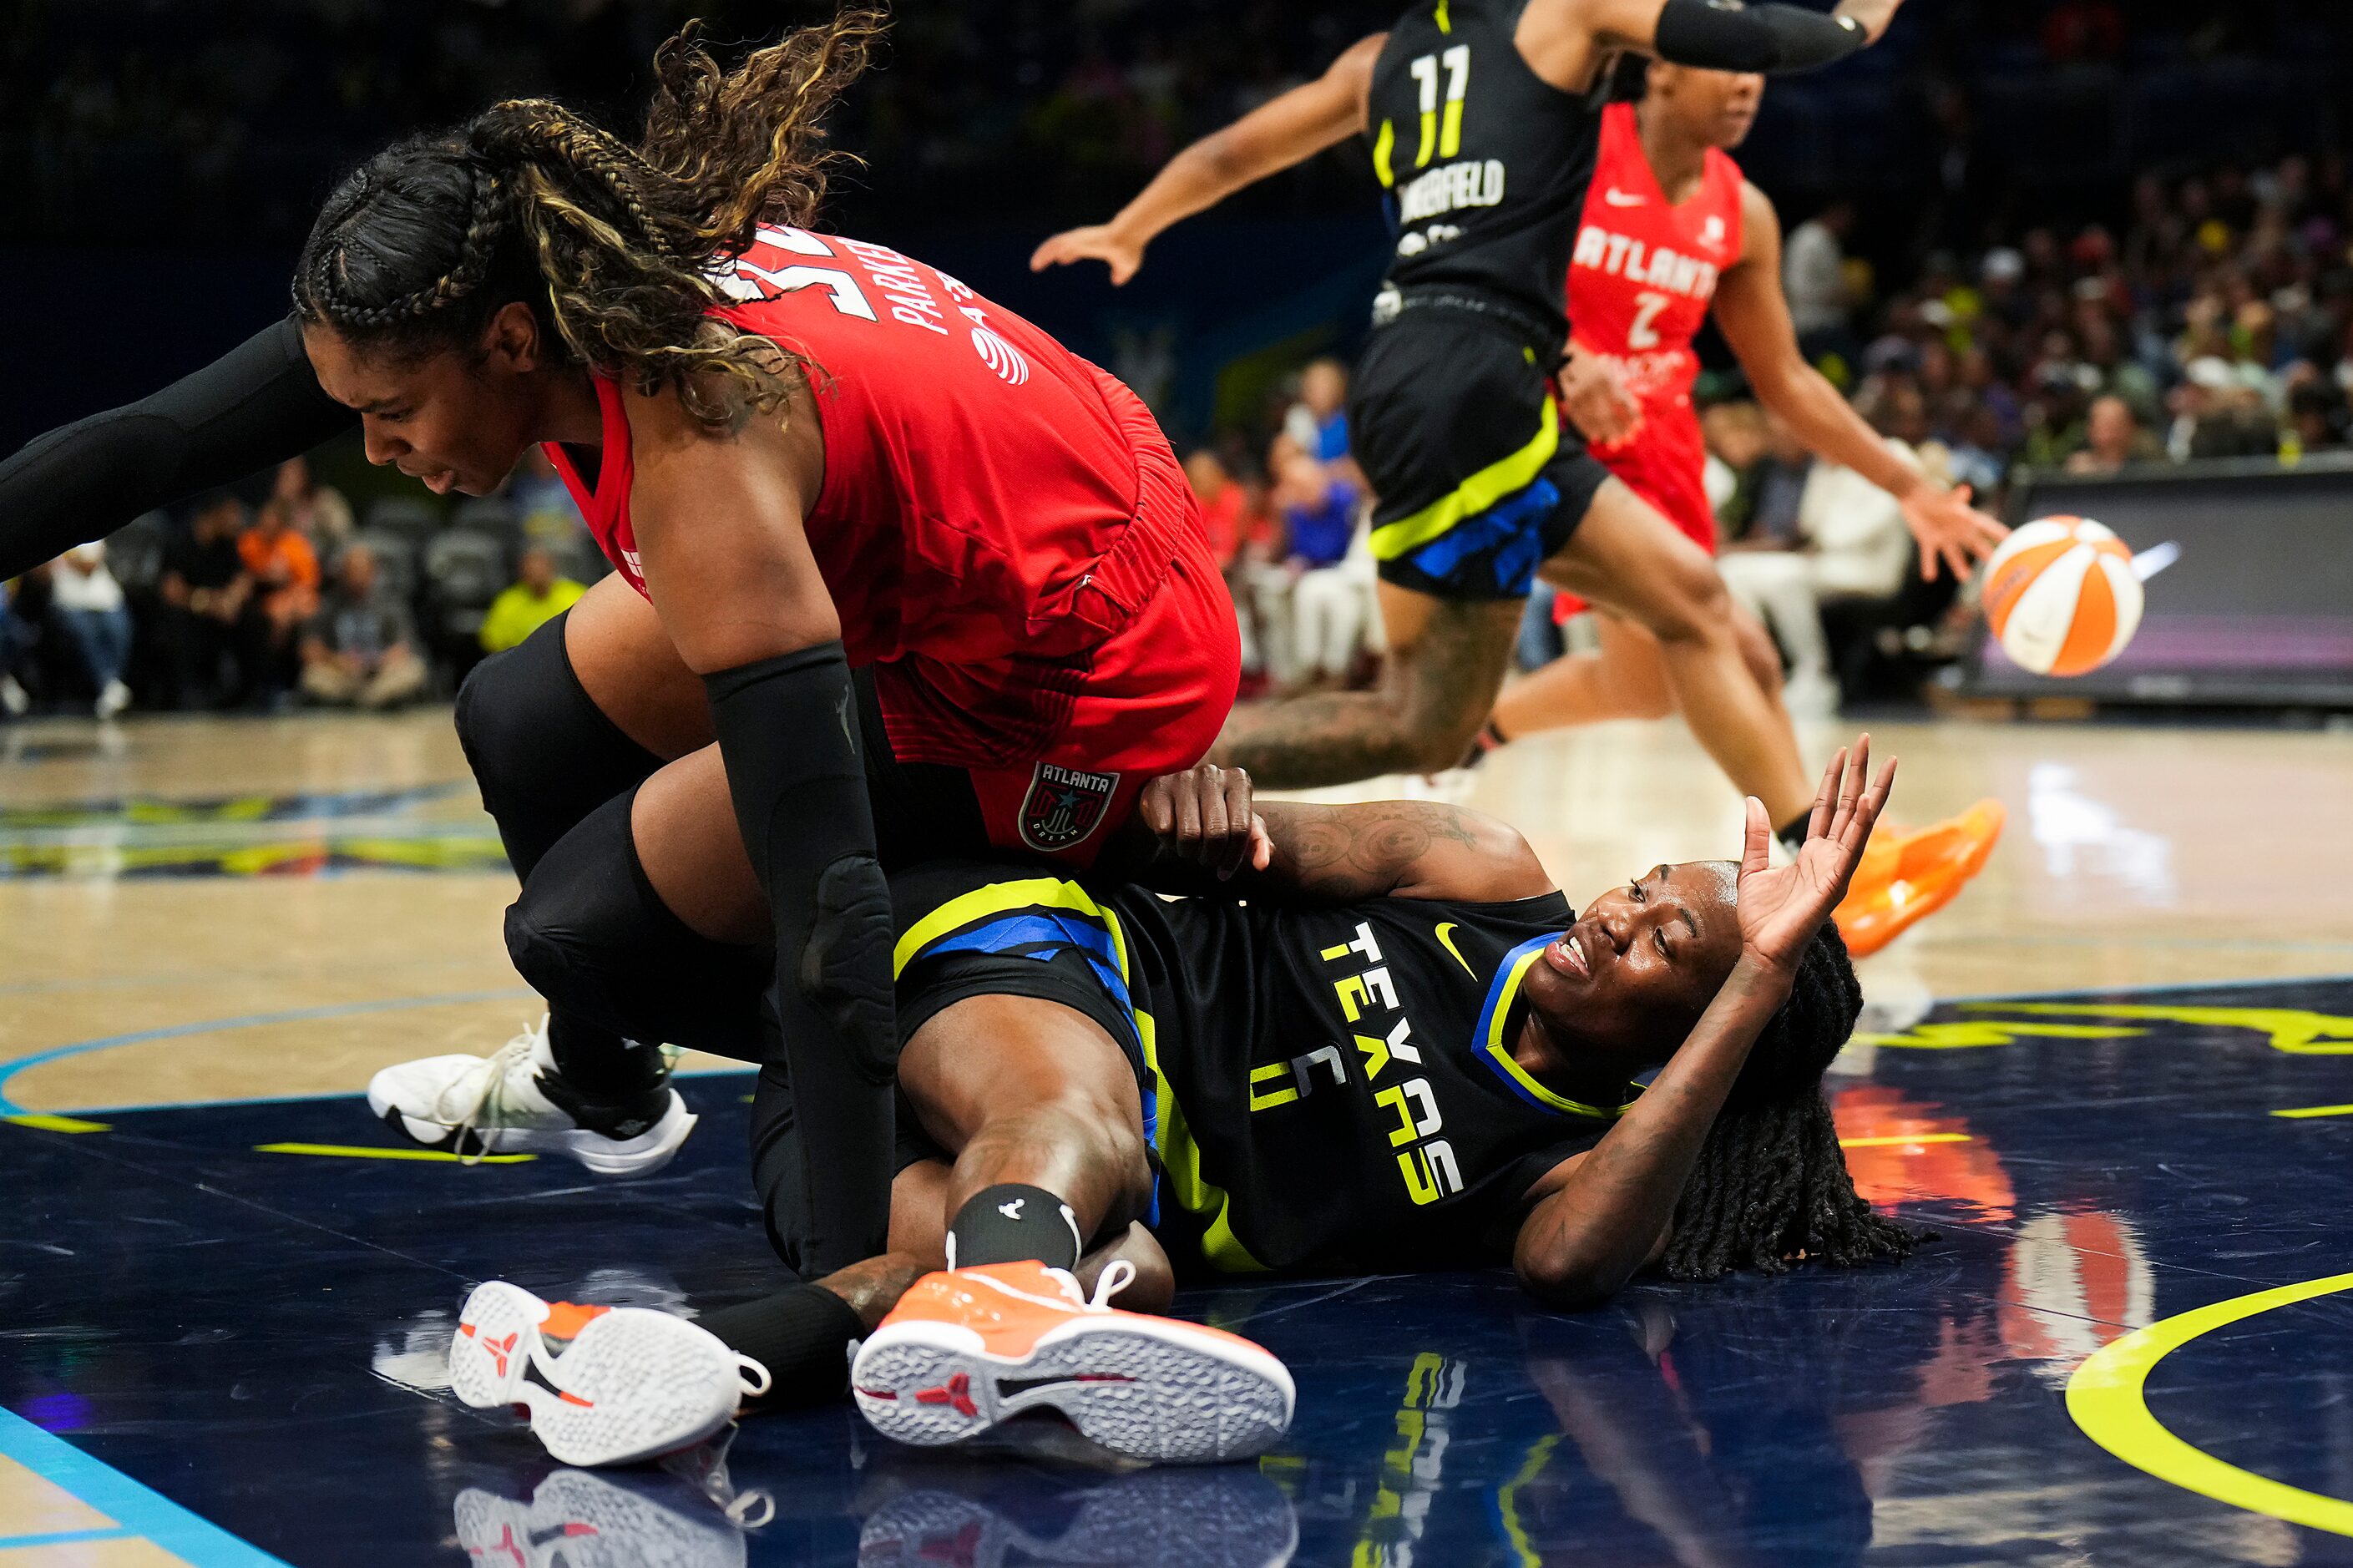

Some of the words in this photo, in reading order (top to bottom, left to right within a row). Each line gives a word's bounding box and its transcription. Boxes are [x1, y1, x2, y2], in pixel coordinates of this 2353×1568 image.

[1410, 43, 1470, 169] 11
[1572, 225, 1718, 299] ATLANT
[1629, 291, 1670, 351] 2
[1042, 764, 1110, 792] ATLANTA
[1033, 822, 1078, 842] DREAM
[1319, 921, 1464, 1206] TEXAS
